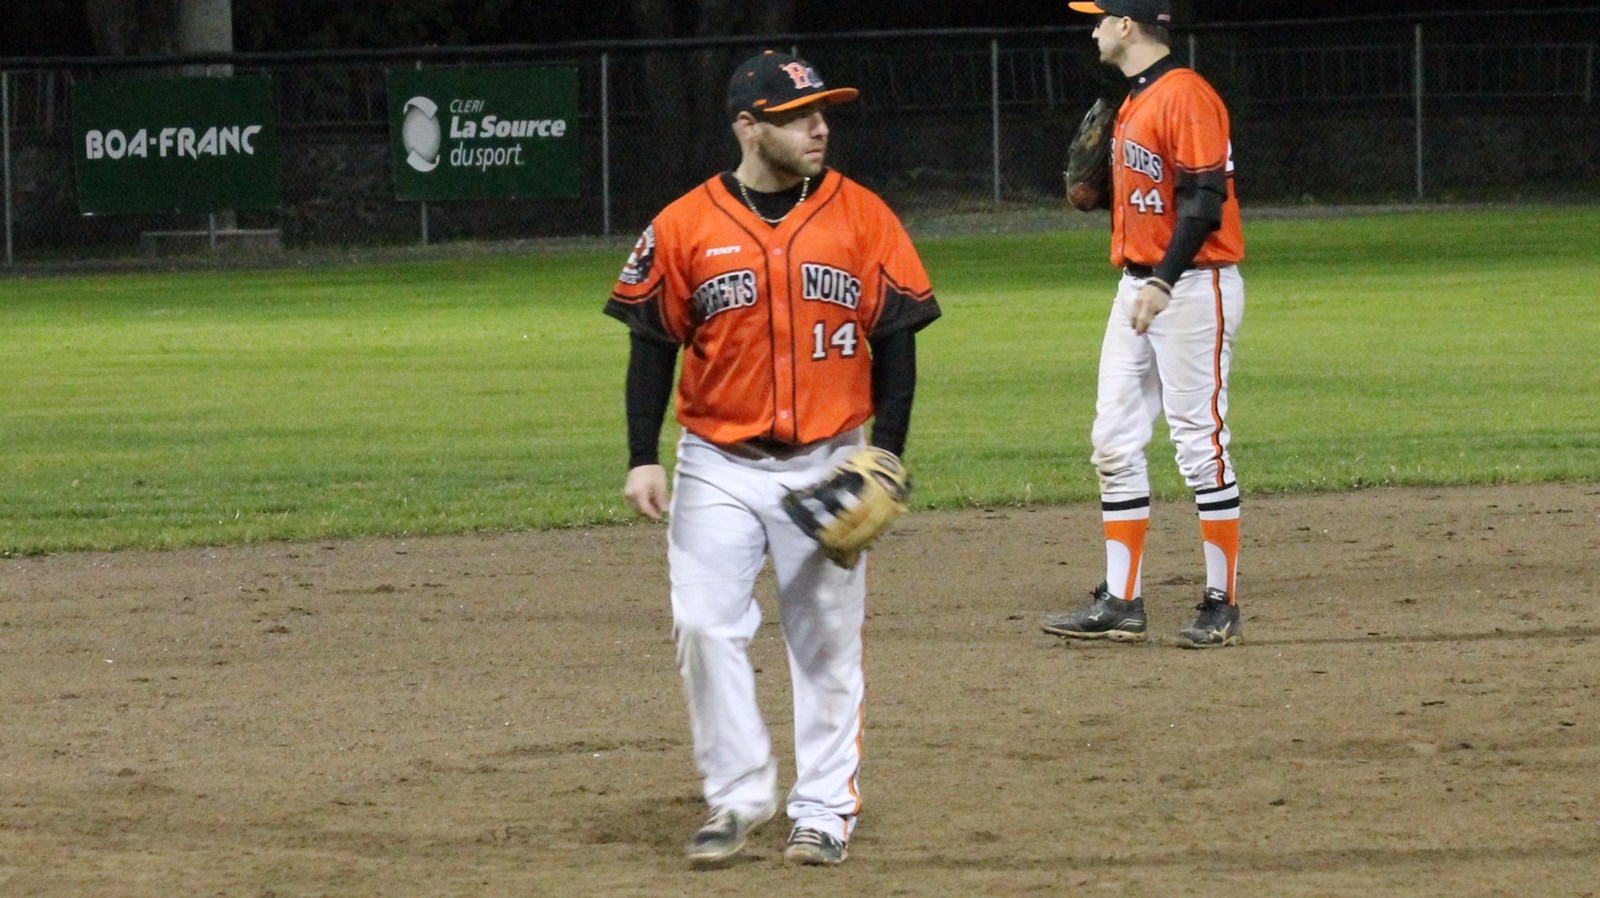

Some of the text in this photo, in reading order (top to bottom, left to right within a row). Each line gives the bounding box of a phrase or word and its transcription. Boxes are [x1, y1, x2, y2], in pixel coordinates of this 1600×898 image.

[450, 99, 485, 113] CLERI
[85, 125, 262, 160] BOA-FRANC
[450, 115, 566, 139] La Source
[450, 141, 522, 172] du sport
[1130, 188, 1164, 214] 44
[801, 263, 861, 310] NOIRS
[812, 321, 857, 360] 14
